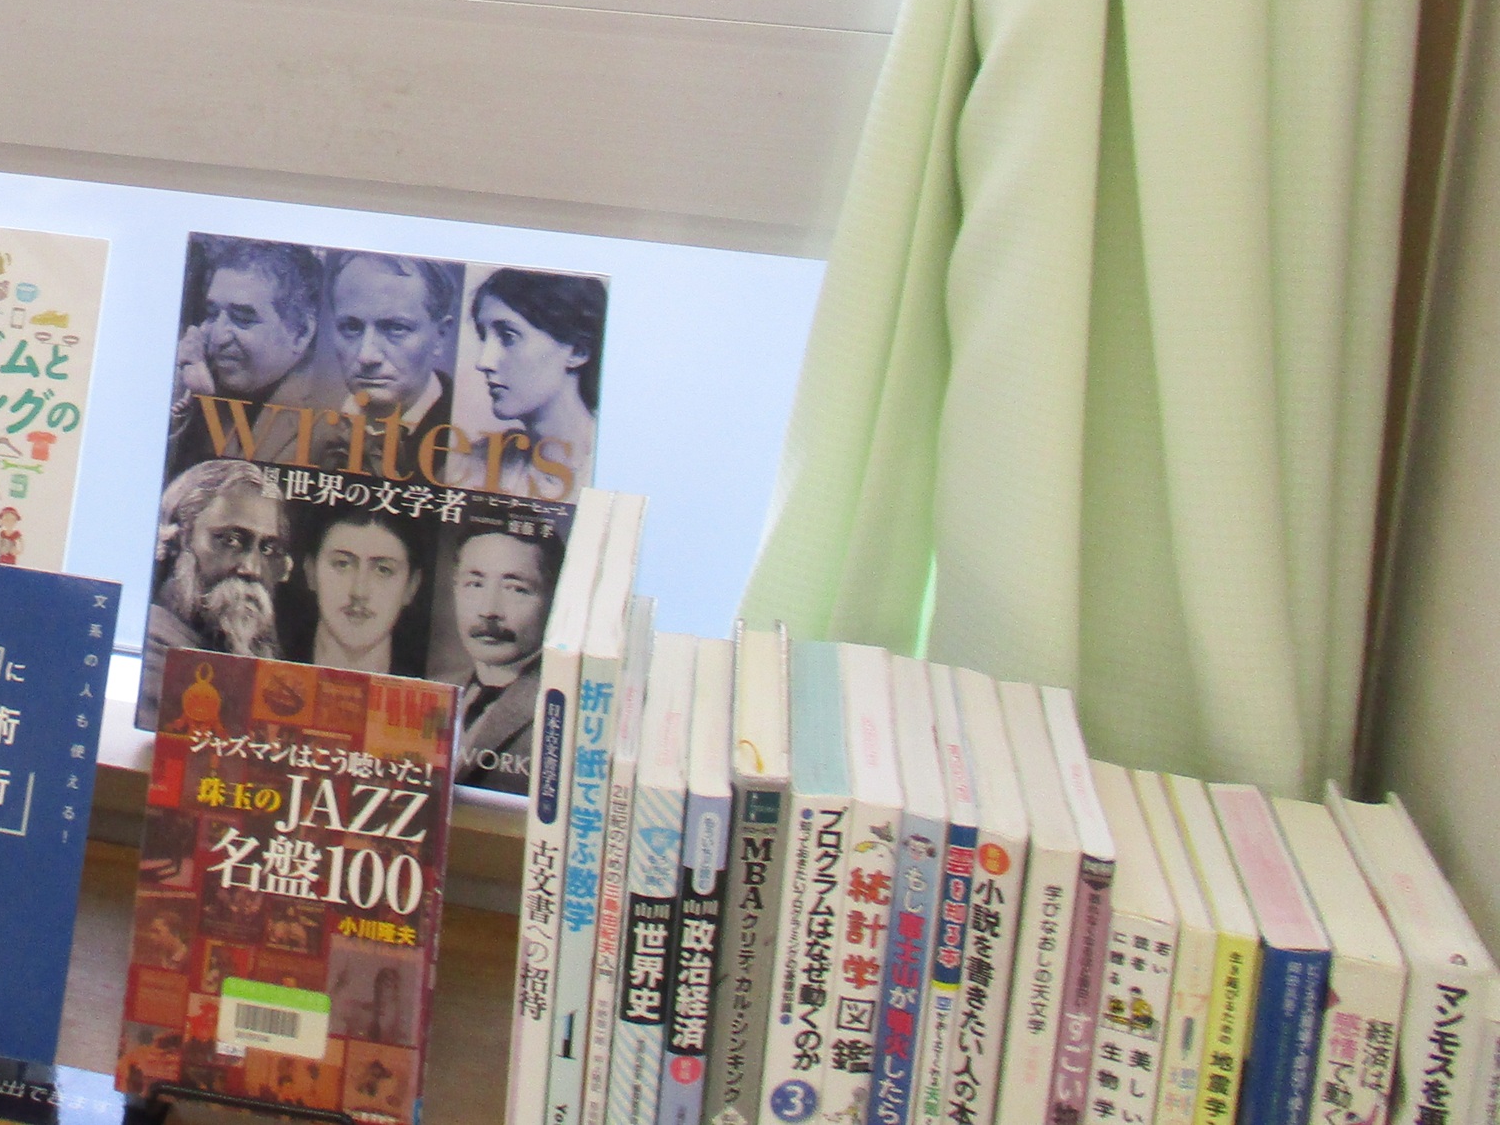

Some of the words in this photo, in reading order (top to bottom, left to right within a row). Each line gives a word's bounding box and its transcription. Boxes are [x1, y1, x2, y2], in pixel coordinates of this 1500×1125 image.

[193, 392, 576, 502] Writers
[282, 469, 468, 525] 世界の文学者
[197, 776, 281, 813] 珠玉の
[274, 774, 430, 844] JAZZ
[562, 678, 613, 934] 折り紙で学ぶ数学
[207, 828, 424, 915] 名盤100
[520, 840, 560, 1022] 古文書への招待
[625, 920, 669, 1022] 世界史
[672, 918, 715, 1053] 政治経済
[791, 806, 848, 1072] プログラムはなぜ動くのか
[832, 867, 893, 1074] 統計学図鑑
